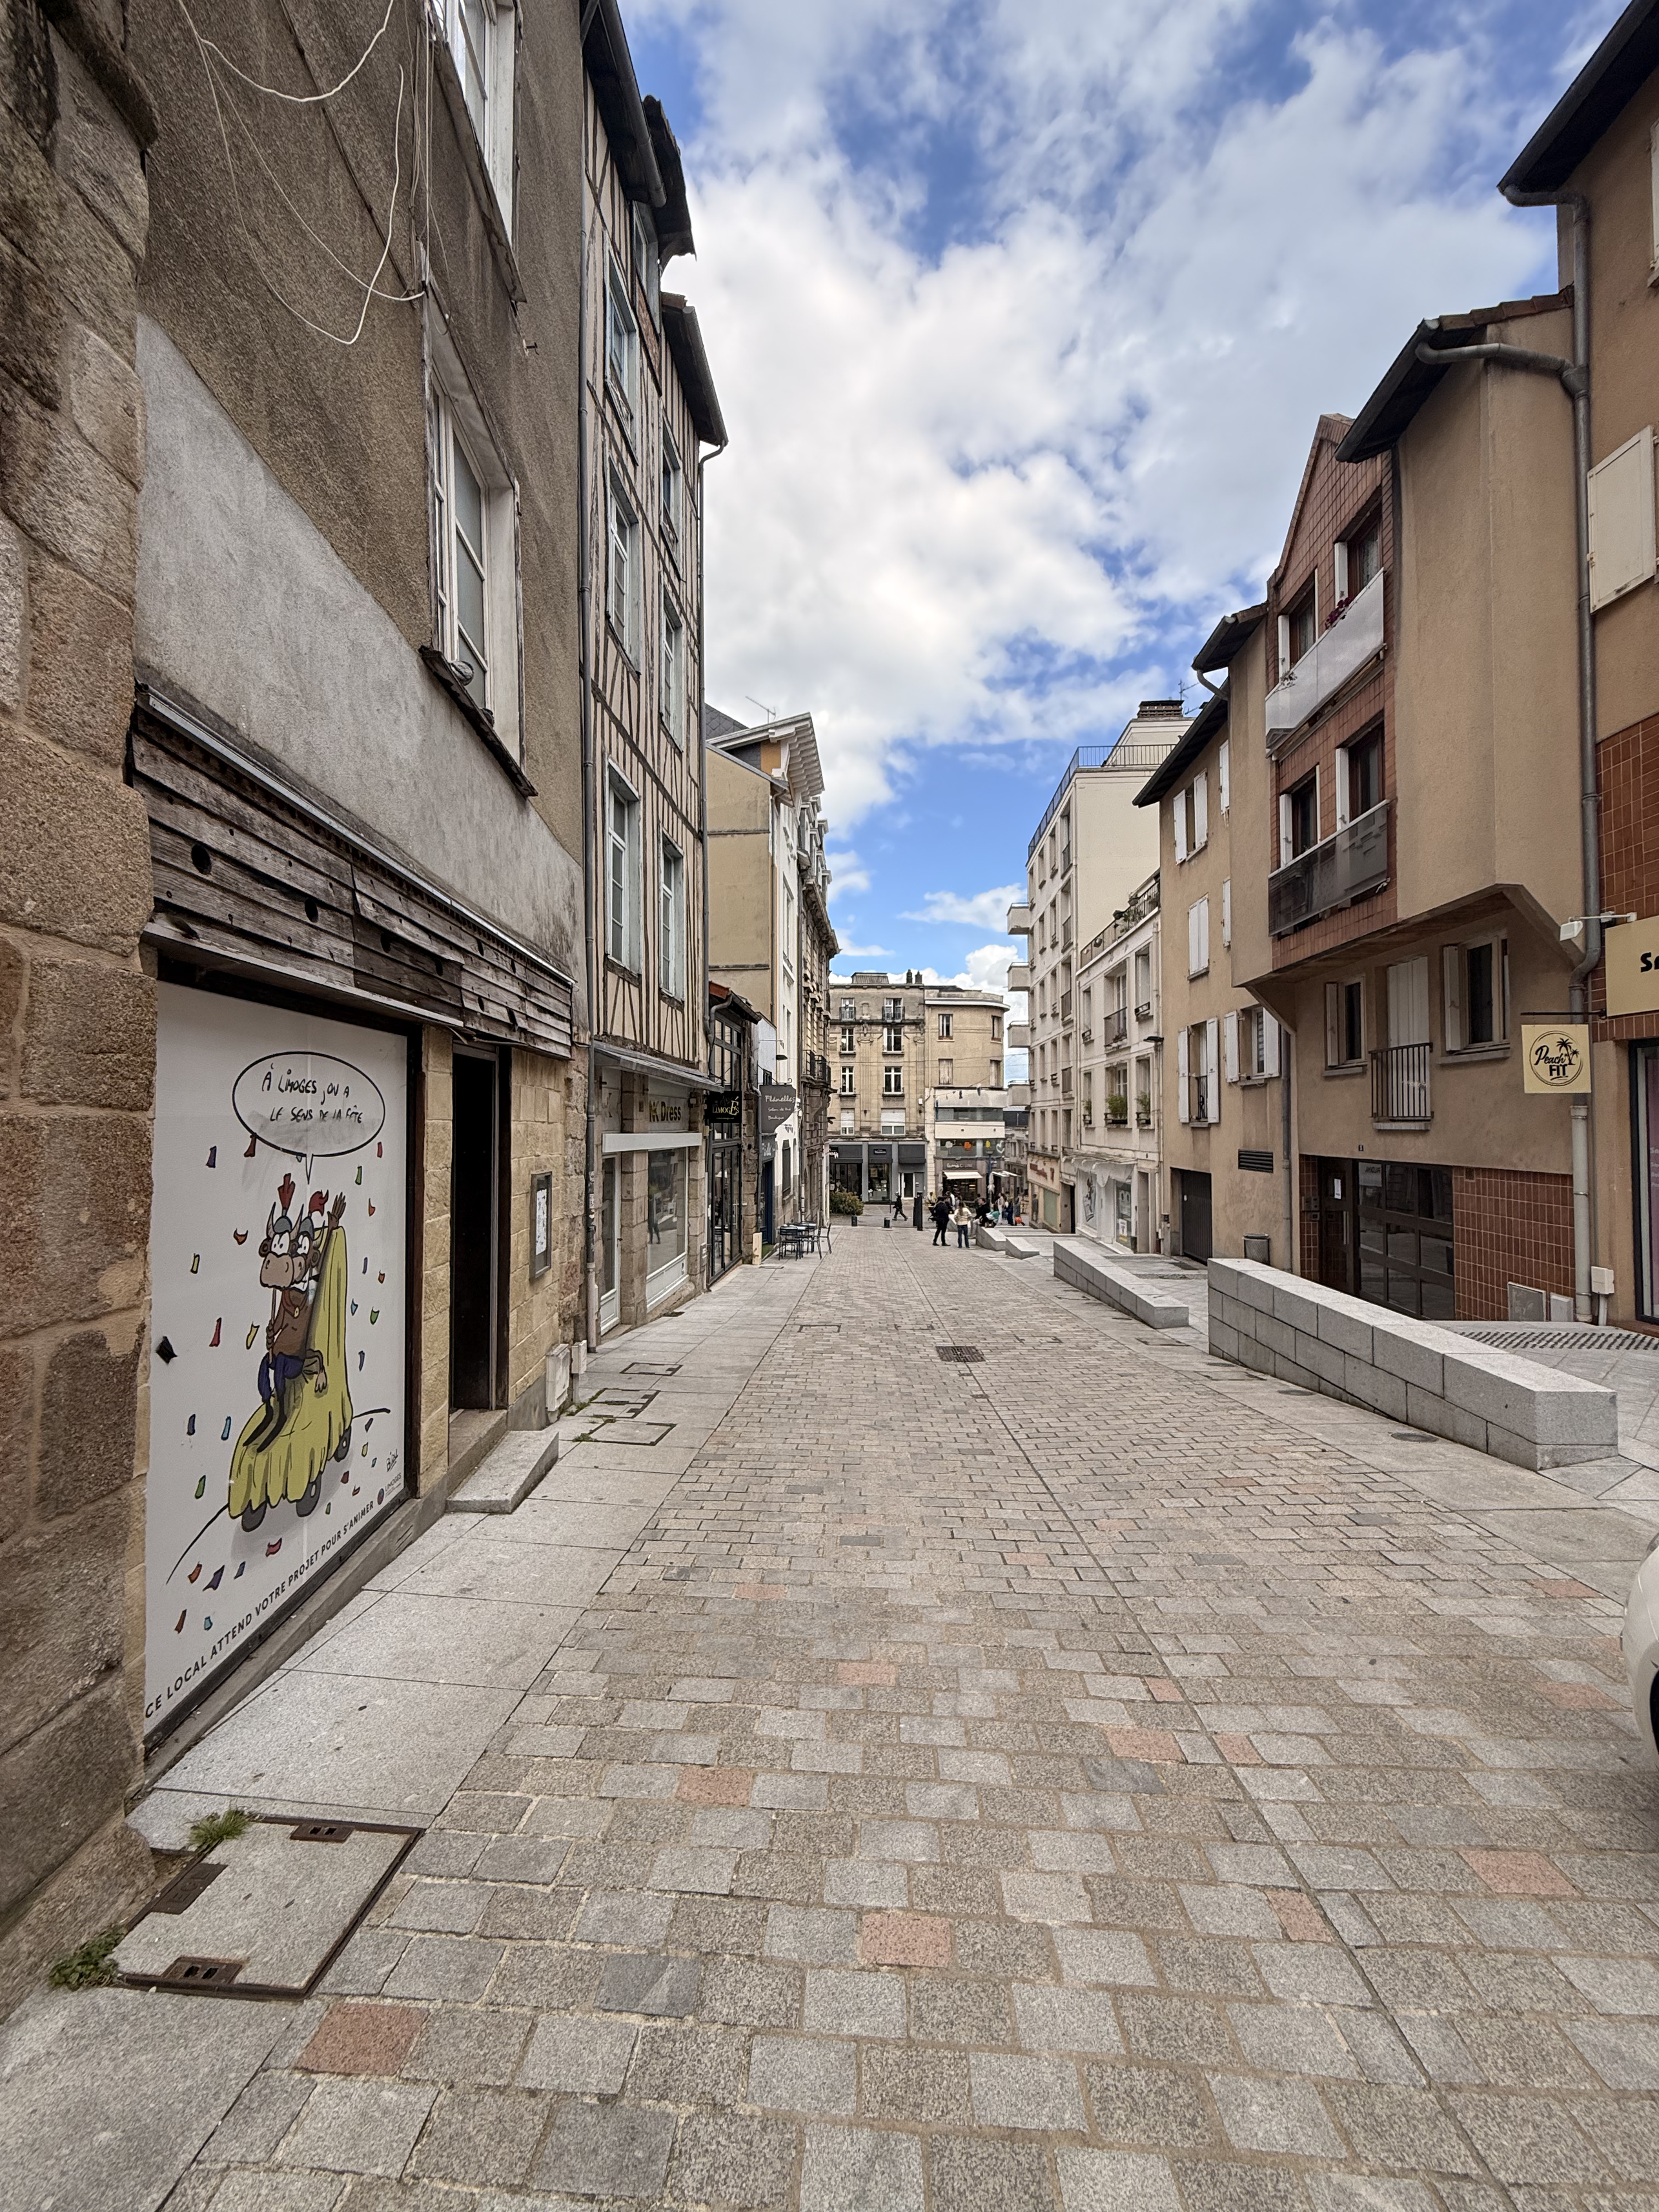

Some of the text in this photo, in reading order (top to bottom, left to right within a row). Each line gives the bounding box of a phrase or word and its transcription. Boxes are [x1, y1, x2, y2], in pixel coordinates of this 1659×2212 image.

[1534, 1045, 1566, 1066] Peach
[1549, 1064, 1567, 1076] FIT
[270, 1107, 283, 1122] LE
[290, 1106, 313, 1122] SENS
[660, 1101, 681, 1122] Dress
[145, 1501, 373, 1718] CE LOCAL ATTEND VOTRE PROJET POUR S'ANIMER
